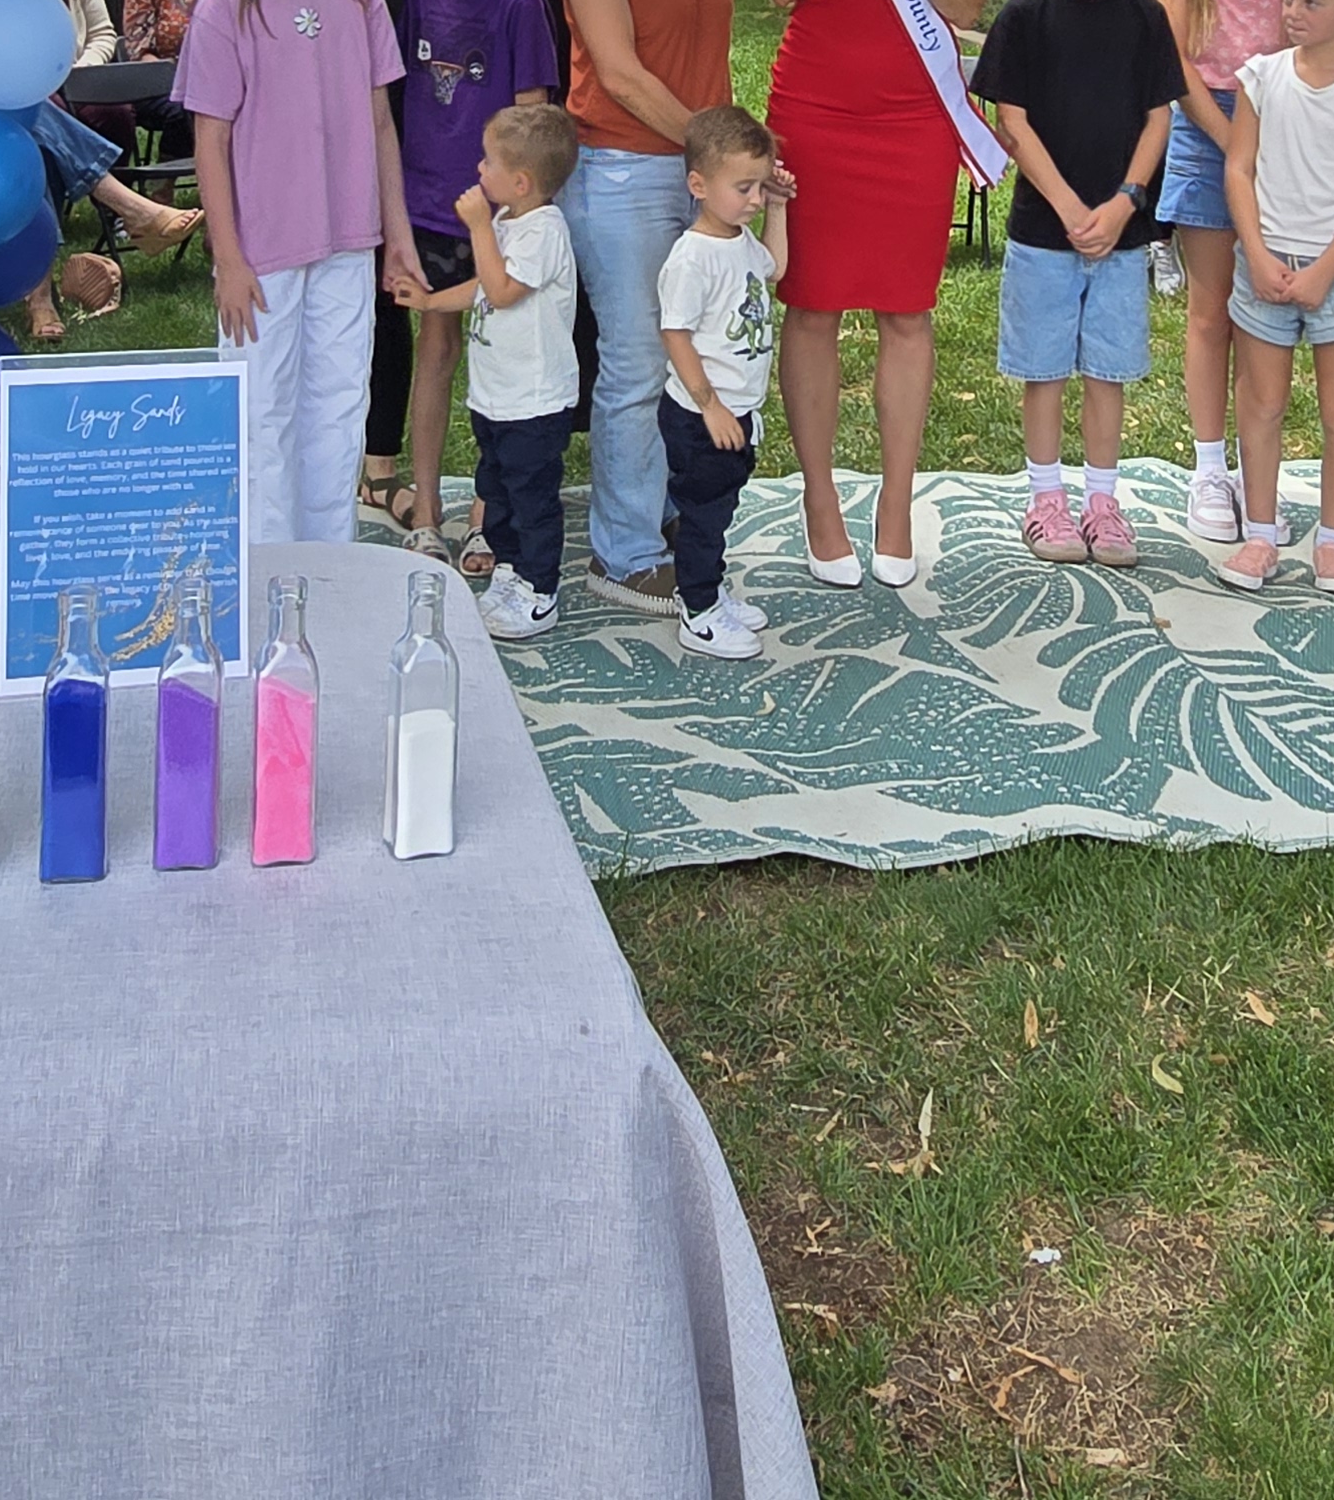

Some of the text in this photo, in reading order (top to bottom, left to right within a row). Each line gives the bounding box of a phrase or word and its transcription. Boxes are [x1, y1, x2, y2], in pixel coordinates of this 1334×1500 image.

[66, 393, 186, 439] Legacy Sands
[12, 452, 30, 461] This
[32, 451, 76, 462] hourglass
[78, 448, 108, 458] stands
[129, 447, 152, 456] quiet
[154, 446, 185, 454] tribute
[18, 465, 38, 474] hold
[68, 462, 97, 472] hearts.
[101, 461, 122, 470] Each
[125, 460, 147, 470] grain
[149, 458, 159, 467] of
[160, 457, 182, 466] sand
[183, 456, 215, 466] poured
[9, 467, 238, 487] reflection of love, memory, and the time shared with
[54, 489, 80, 497] those
[81, 487, 101, 495] who
[132, 484, 160, 494] longer
[162, 482, 182, 491] with
[183, 482, 195, 490] us.
[33, 515, 41, 523] If
[42, 516, 60, 525] you
[61, 513, 84, 522] wish,
[86, 512, 105, 520] take
[114, 510, 152, 519] moment
[165, 507, 182, 516] add
[9, 527, 73, 537] rememrance
[75, 525, 85, 534] of
[86, 524, 126, 533] someone
[151, 521, 161, 529] to
[183, 518, 194, 527] As
[213, 516, 238, 524] sands
[19, 542, 52, 552] gather,
[54, 540, 74, 549] they
[76, 538, 98, 546] form
[107, 534, 151, 543] collective
[25, 551, 49, 562] live,
[51, 553, 73, 561] love,
[75, 550, 92, 559] and
[94, 550, 109, 558] the
[111, 547, 151, 557] endring
[190, 543, 200, 551] of
[201, 543, 222, 552] me.
[11, 580, 31, 590] May
[52, 577, 95, 586] hourglass
[97, 574, 122, 583] serve
[10, 593, 31, 602] time
[32, 591, 59, 600] move
[104, 587, 120, 595] the
[121, 583, 150, 595] legacy
